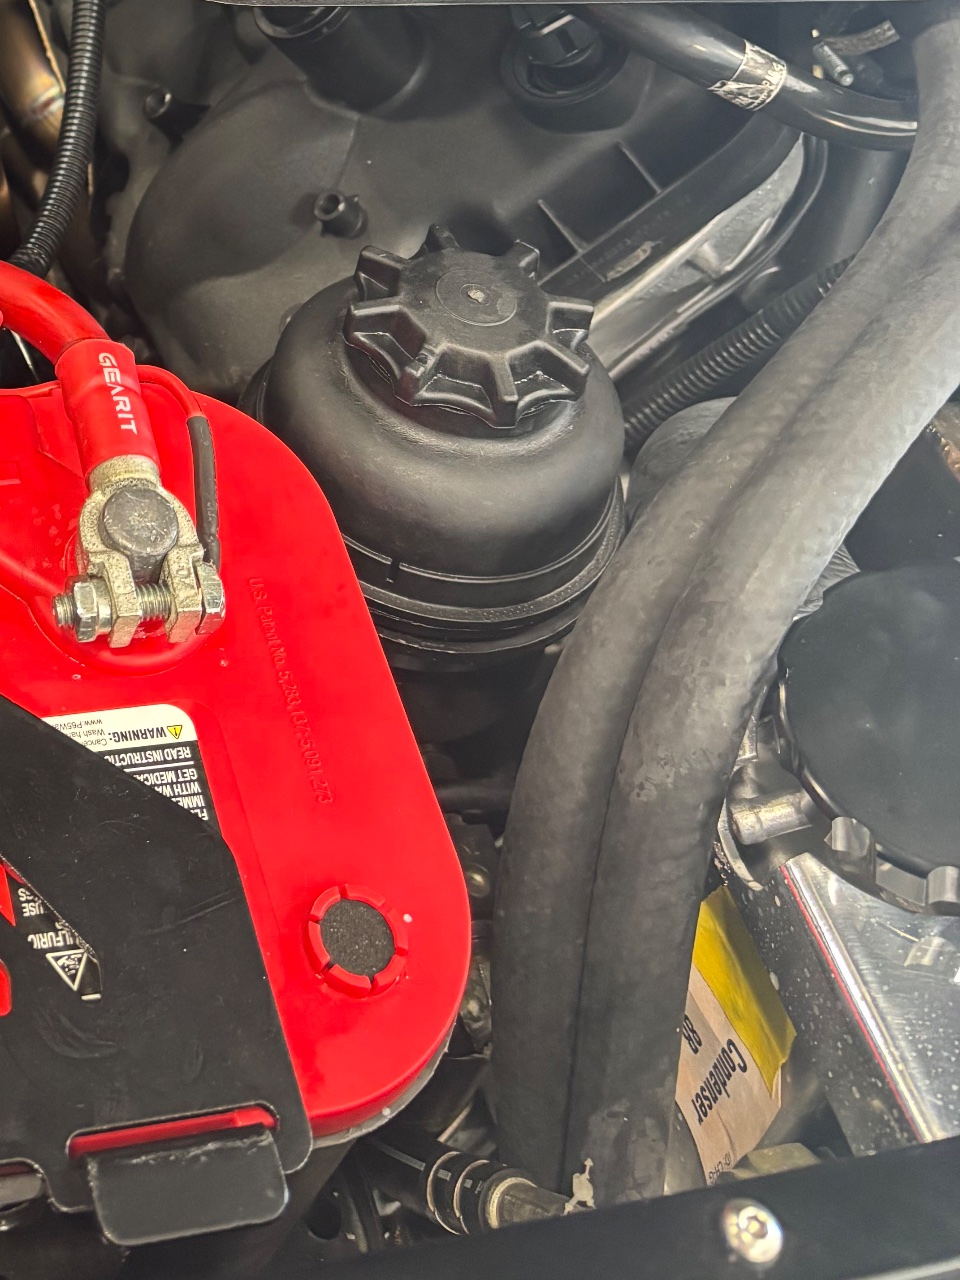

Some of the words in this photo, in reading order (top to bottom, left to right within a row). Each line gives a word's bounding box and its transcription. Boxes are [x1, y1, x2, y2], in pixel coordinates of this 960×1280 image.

[97, 351, 138, 436] GEARIT
[82, 729, 105, 737] Wash
[108, 725, 167, 742] WARNING:
[164, 746, 192, 759] READ
[177, 768, 198, 782] GET
[173, 781, 201, 796] WITH
[691, 1038, 748, 1125] Condenser
